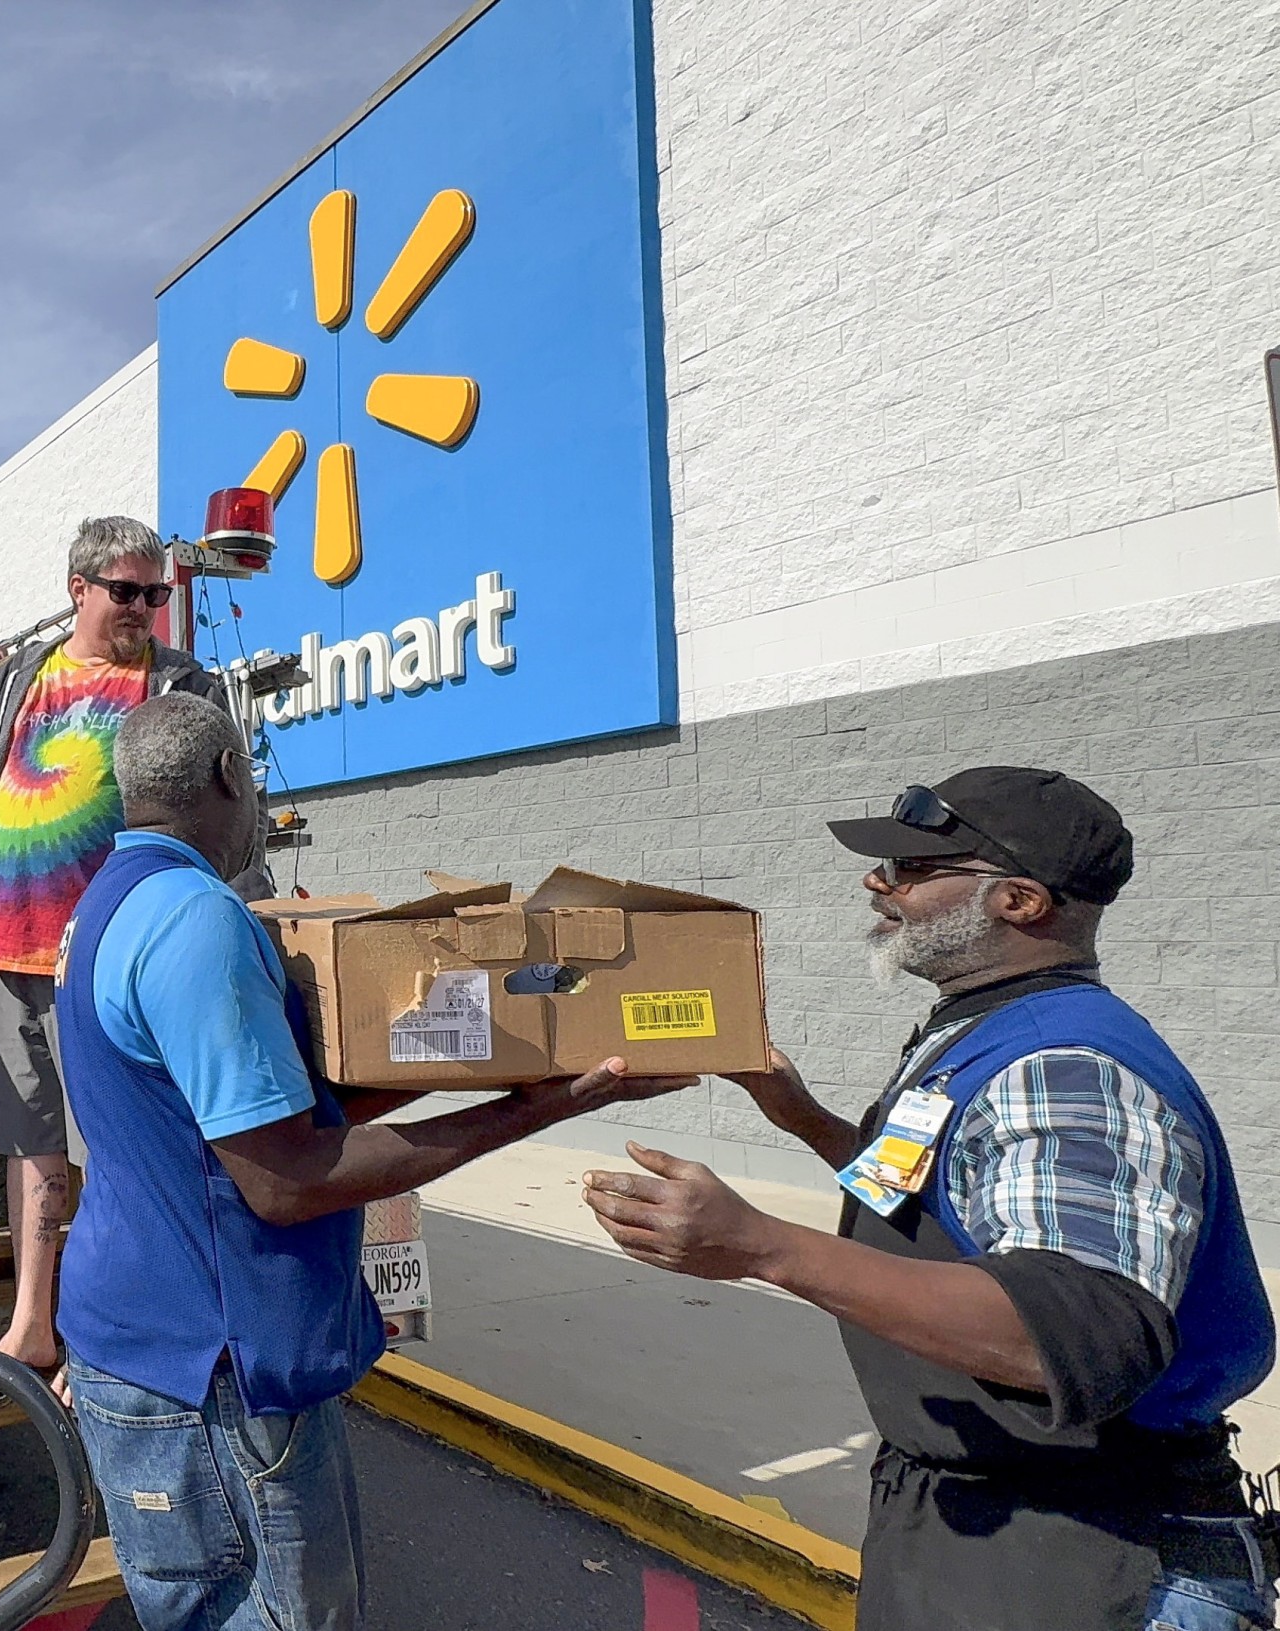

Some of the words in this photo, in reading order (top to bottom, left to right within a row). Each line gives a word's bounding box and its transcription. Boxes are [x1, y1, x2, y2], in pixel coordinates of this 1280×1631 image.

[623, 995, 652, 1003] CARGILL
[652, 993, 670, 1001] MEAT
[671, 992, 709, 1000] SOLUTIONS
[363, 1245, 408, 1261] EORGIA
[362, 1259, 421, 1296] JN599
